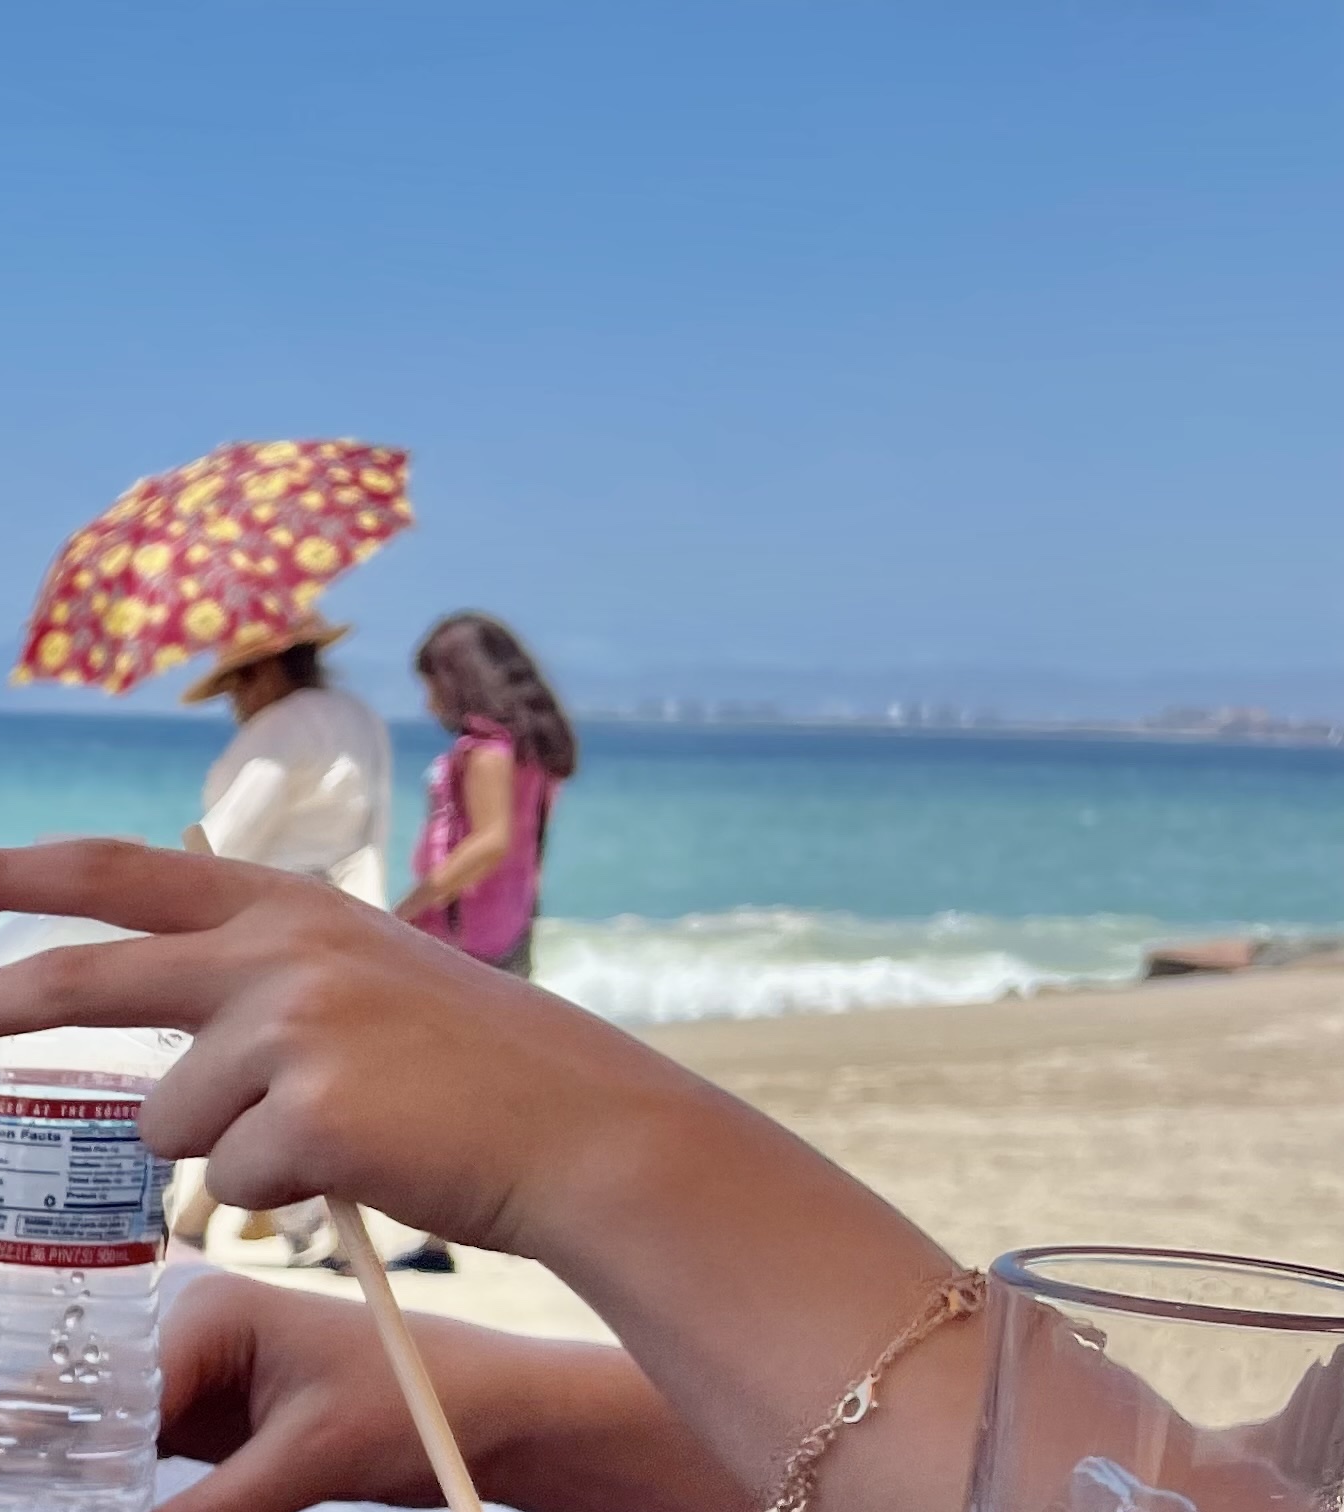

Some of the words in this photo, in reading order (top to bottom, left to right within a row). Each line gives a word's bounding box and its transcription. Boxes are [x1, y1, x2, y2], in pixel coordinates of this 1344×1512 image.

[33, 1103, 50, 1117] AT
[61, 1104, 85, 1118] THE
[21, 1129, 61, 1142] Facts
